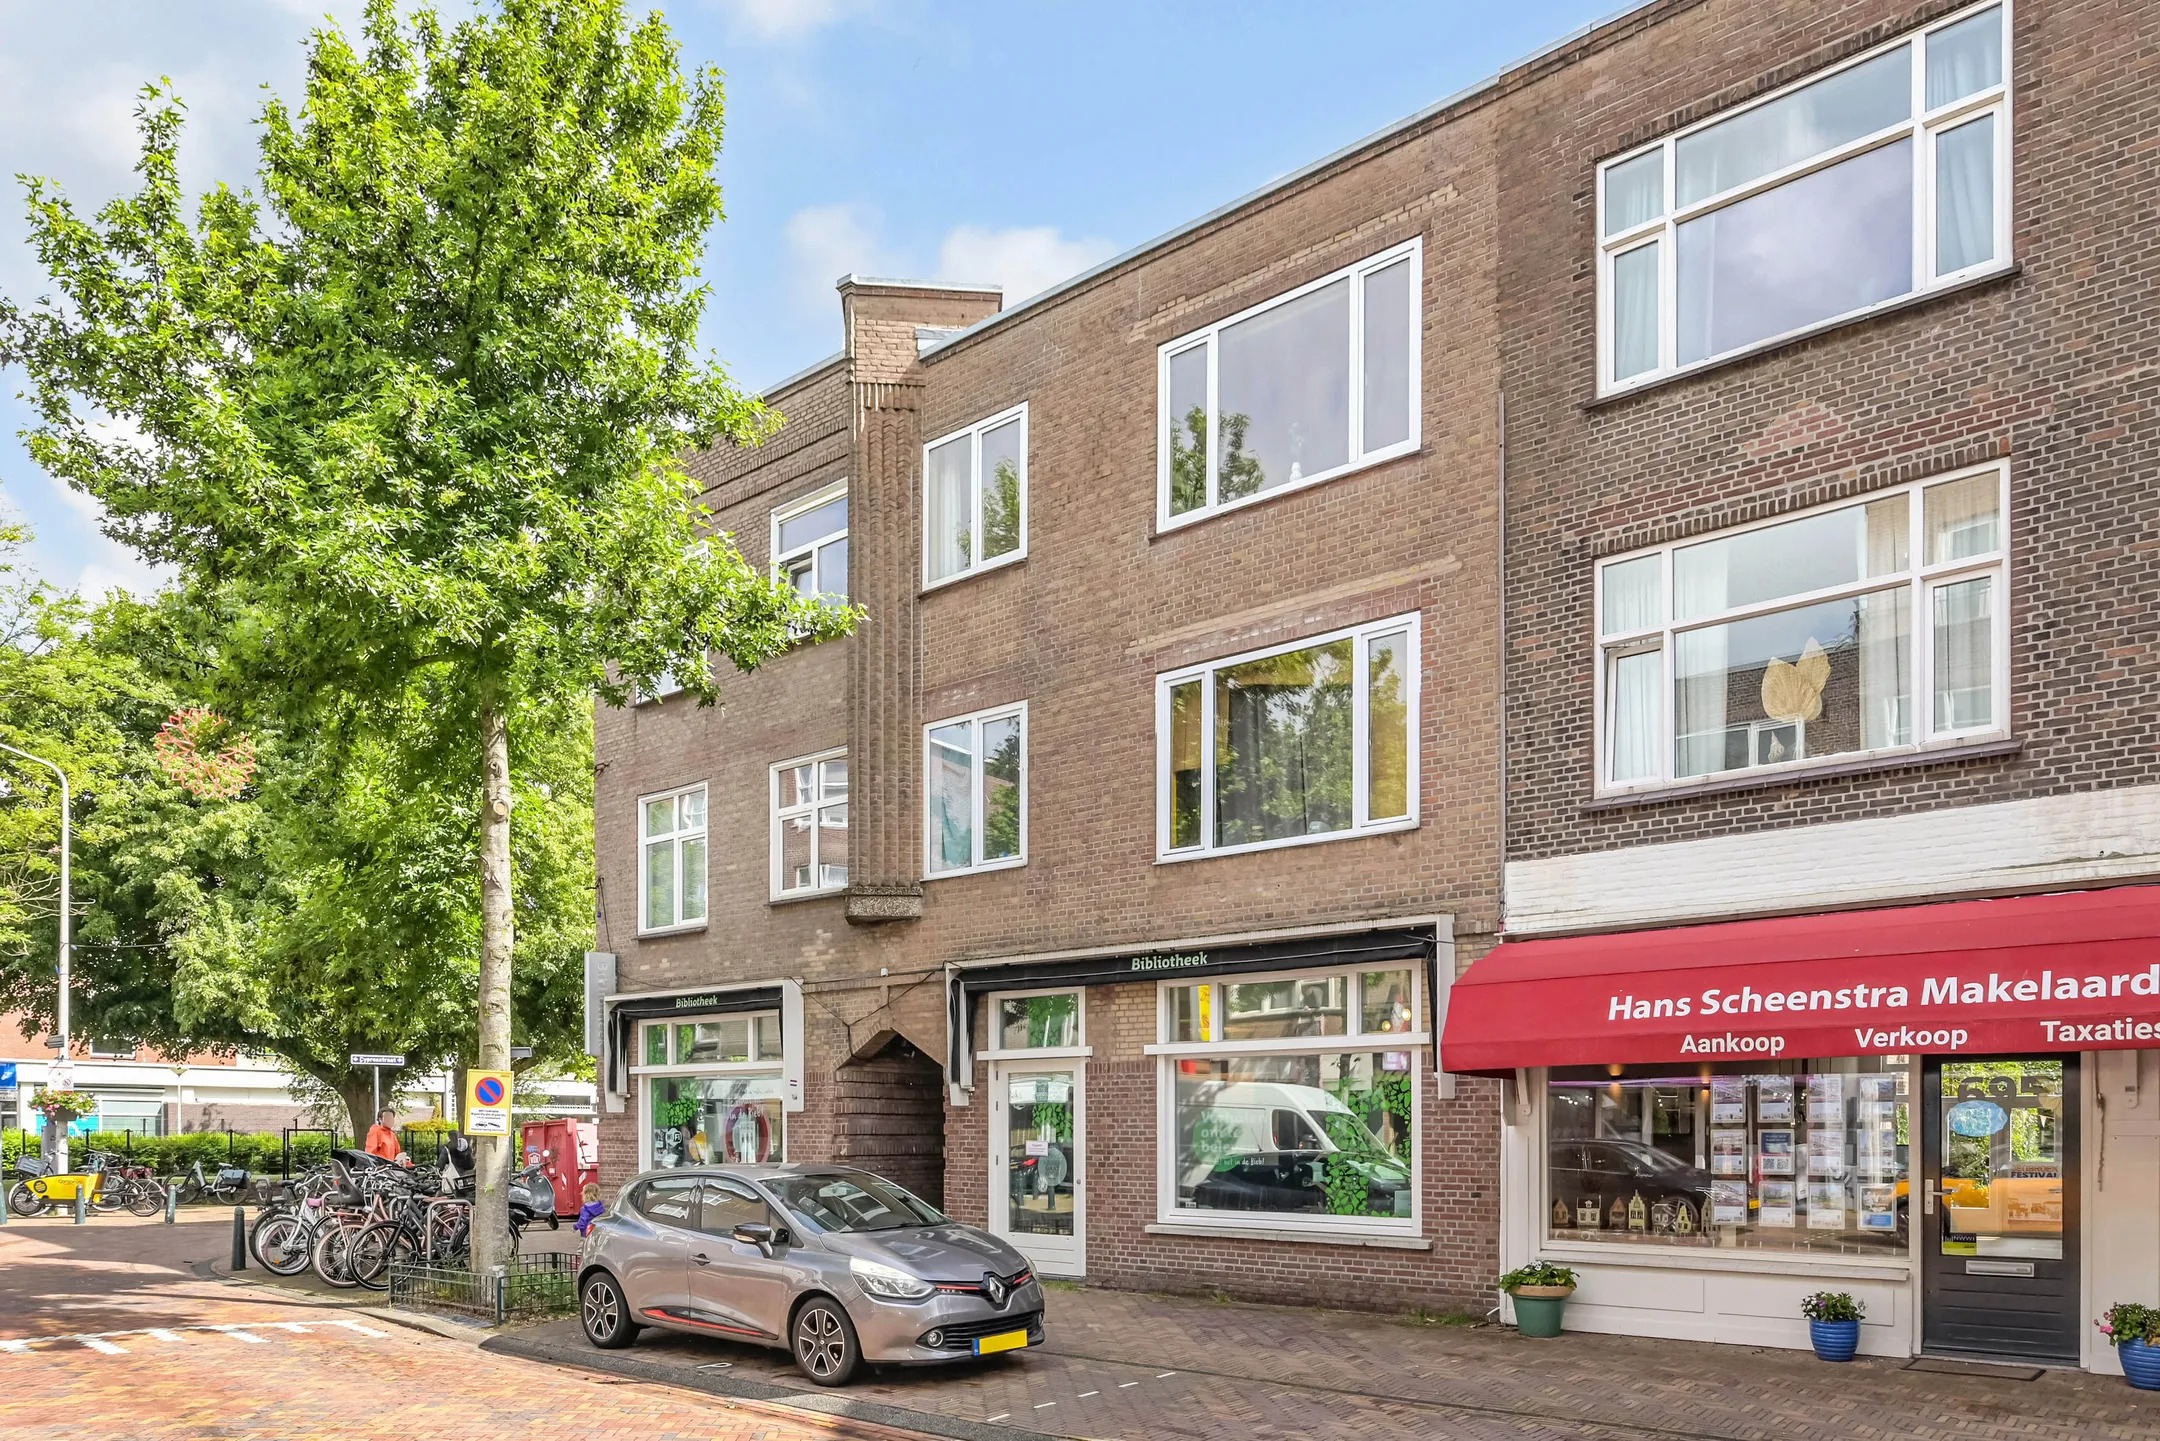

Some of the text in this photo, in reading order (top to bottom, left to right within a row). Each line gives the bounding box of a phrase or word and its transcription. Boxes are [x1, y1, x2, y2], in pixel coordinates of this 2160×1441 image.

[1131, 951, 1208, 971] Bibliotheek
[675, 994, 718, 1008] Bibliotheek
[1608, 963, 2160, 1021] Hans Scheenstra Makelaard
[1680, 1032, 1786, 1056] Aankoop
[1854, 1025, 1968, 1050] Verkoop
